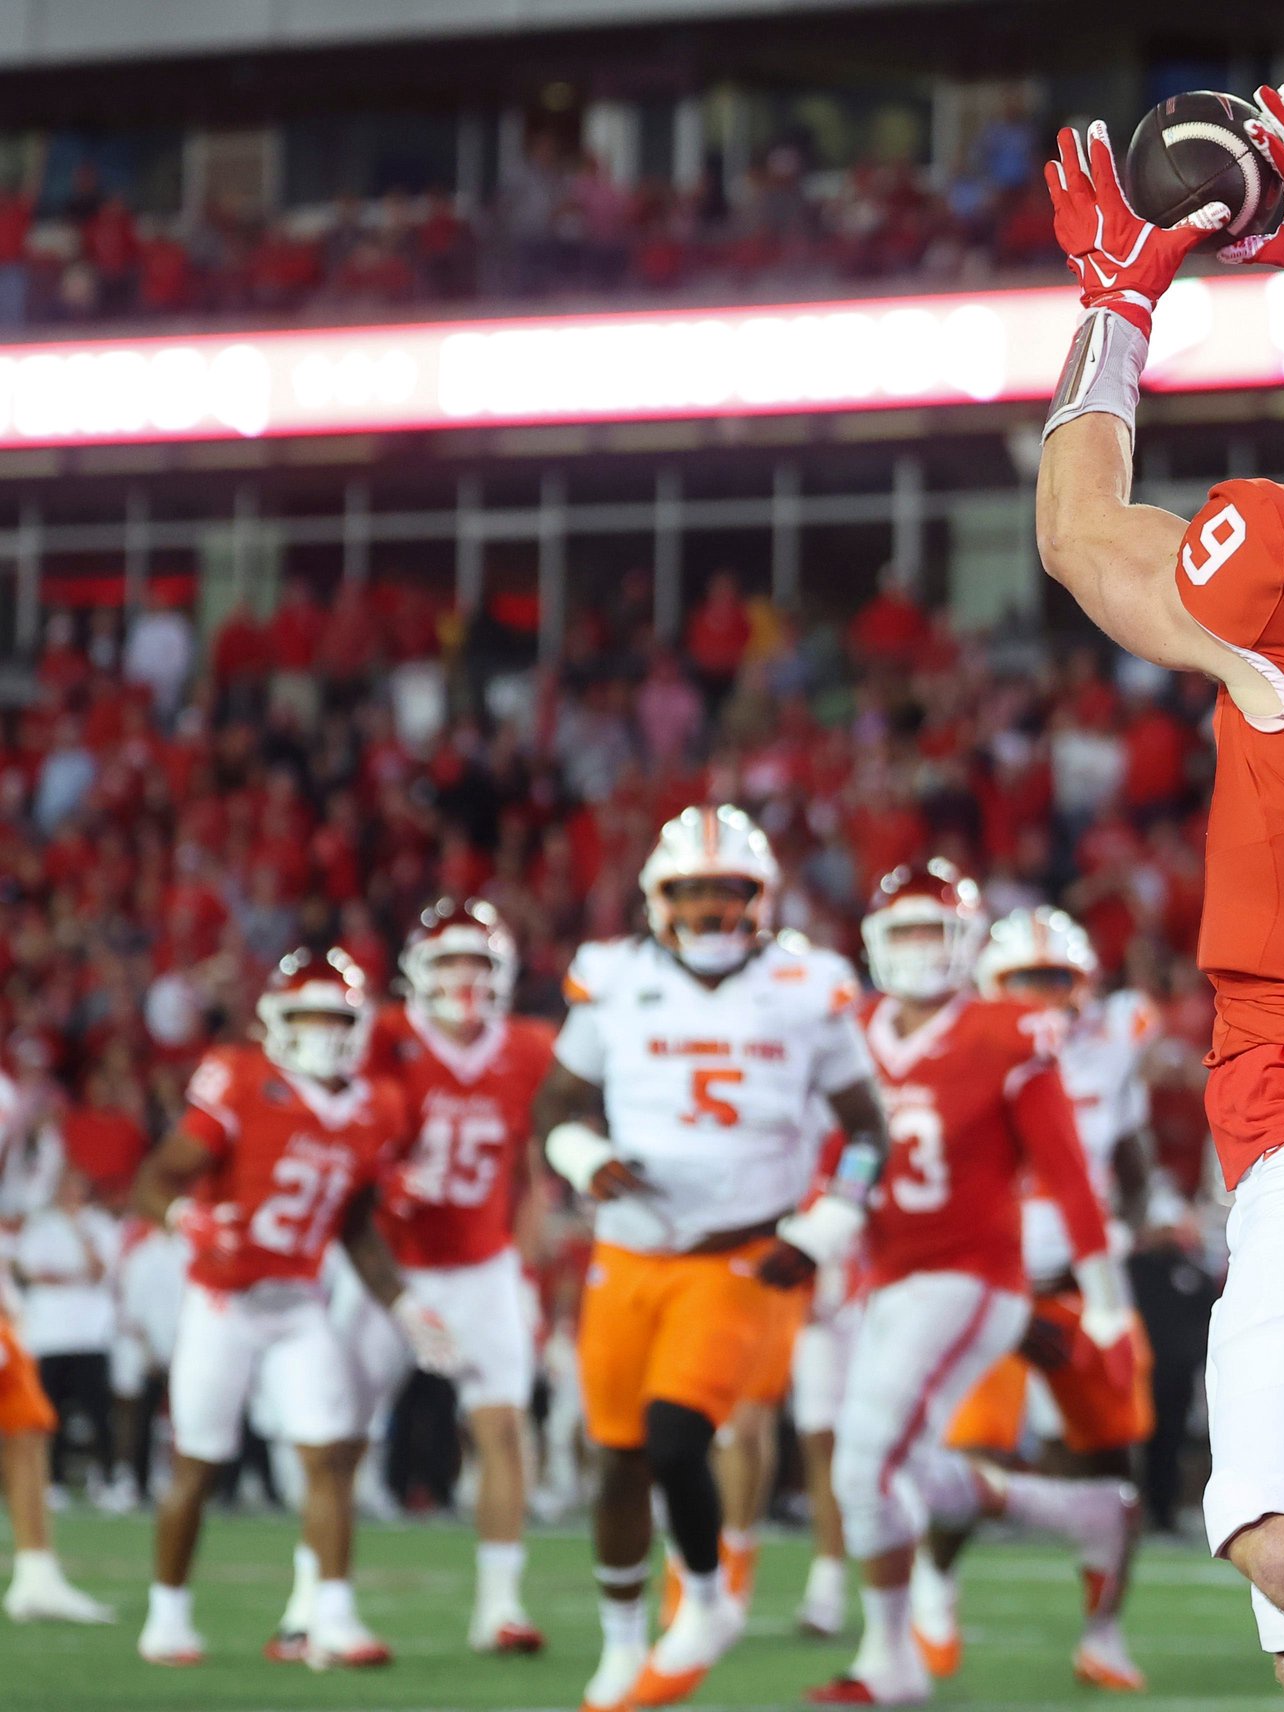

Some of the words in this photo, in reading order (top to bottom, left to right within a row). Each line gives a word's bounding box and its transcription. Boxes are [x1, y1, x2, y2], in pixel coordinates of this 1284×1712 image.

[1182, 503, 1246, 586] 9
[678, 1067, 744, 1128] 5
[412, 1114, 506, 1207] 45
[250, 1156, 351, 1257] 21
